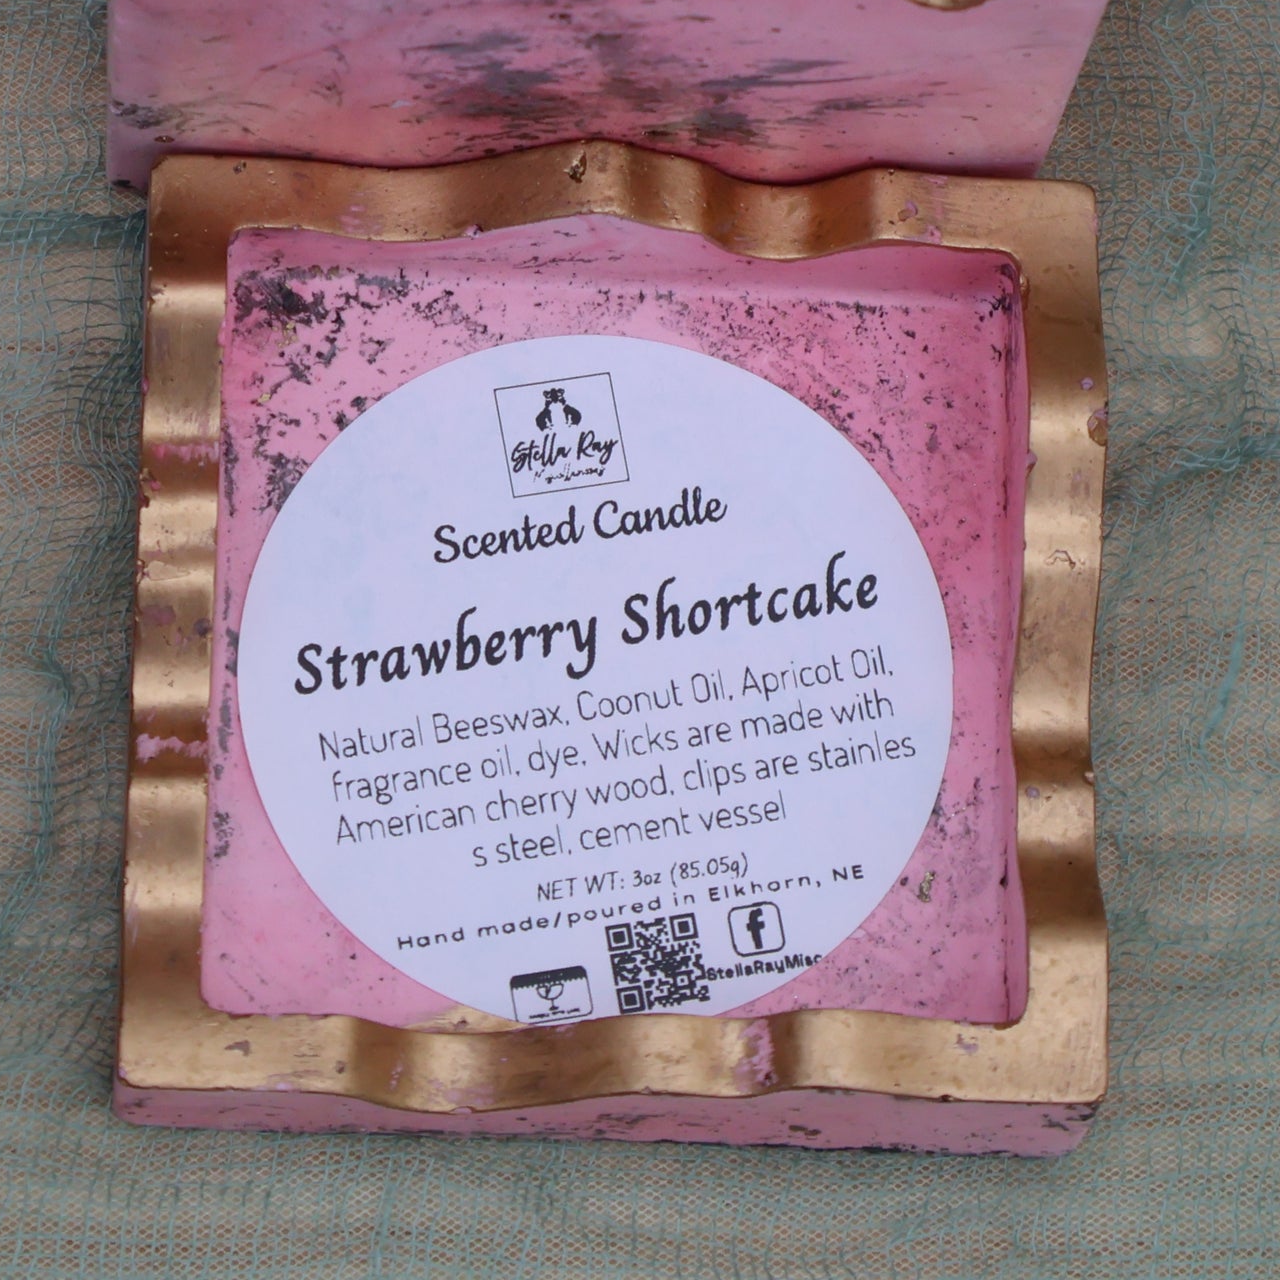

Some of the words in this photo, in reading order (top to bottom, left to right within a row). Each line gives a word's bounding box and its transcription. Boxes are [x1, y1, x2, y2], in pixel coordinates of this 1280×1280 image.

[511, 432, 571, 473] Stella
[577, 430, 619, 465] Ray
[433, 504, 586, 564] Scented
[592, 486, 729, 540] Candle
[293, 605, 598, 696] Strawberry
[620, 549, 879, 646] Shortcake
[318, 715, 424, 762] Natural
[576, 679, 684, 722] Coonut
[741, 654, 845, 702] Apricot
[332, 761, 472, 806] fragrance
[591, 722, 679, 761] Wicks
[687, 721, 733, 748] are
[740, 699, 824, 740] made
[829, 687, 895, 725] with
[336, 804, 476, 846] American
[485, 788, 578, 822] cherry
[682, 758, 747, 797] clips
[754, 754, 800, 781] are
[807, 730, 917, 773] stainles
[579, 807, 692, 851] cement
[698, 789, 787, 832] vessel
[397, 926, 465, 951] Hand
[477, 895, 662, 938] made/poured
[672, 891, 696, 907] in
[831, 864, 865, 882] NE
[537, 877, 578, 902] NET
[584, 870, 625, 895] WT:
[632, 869, 662, 888] 3oz
